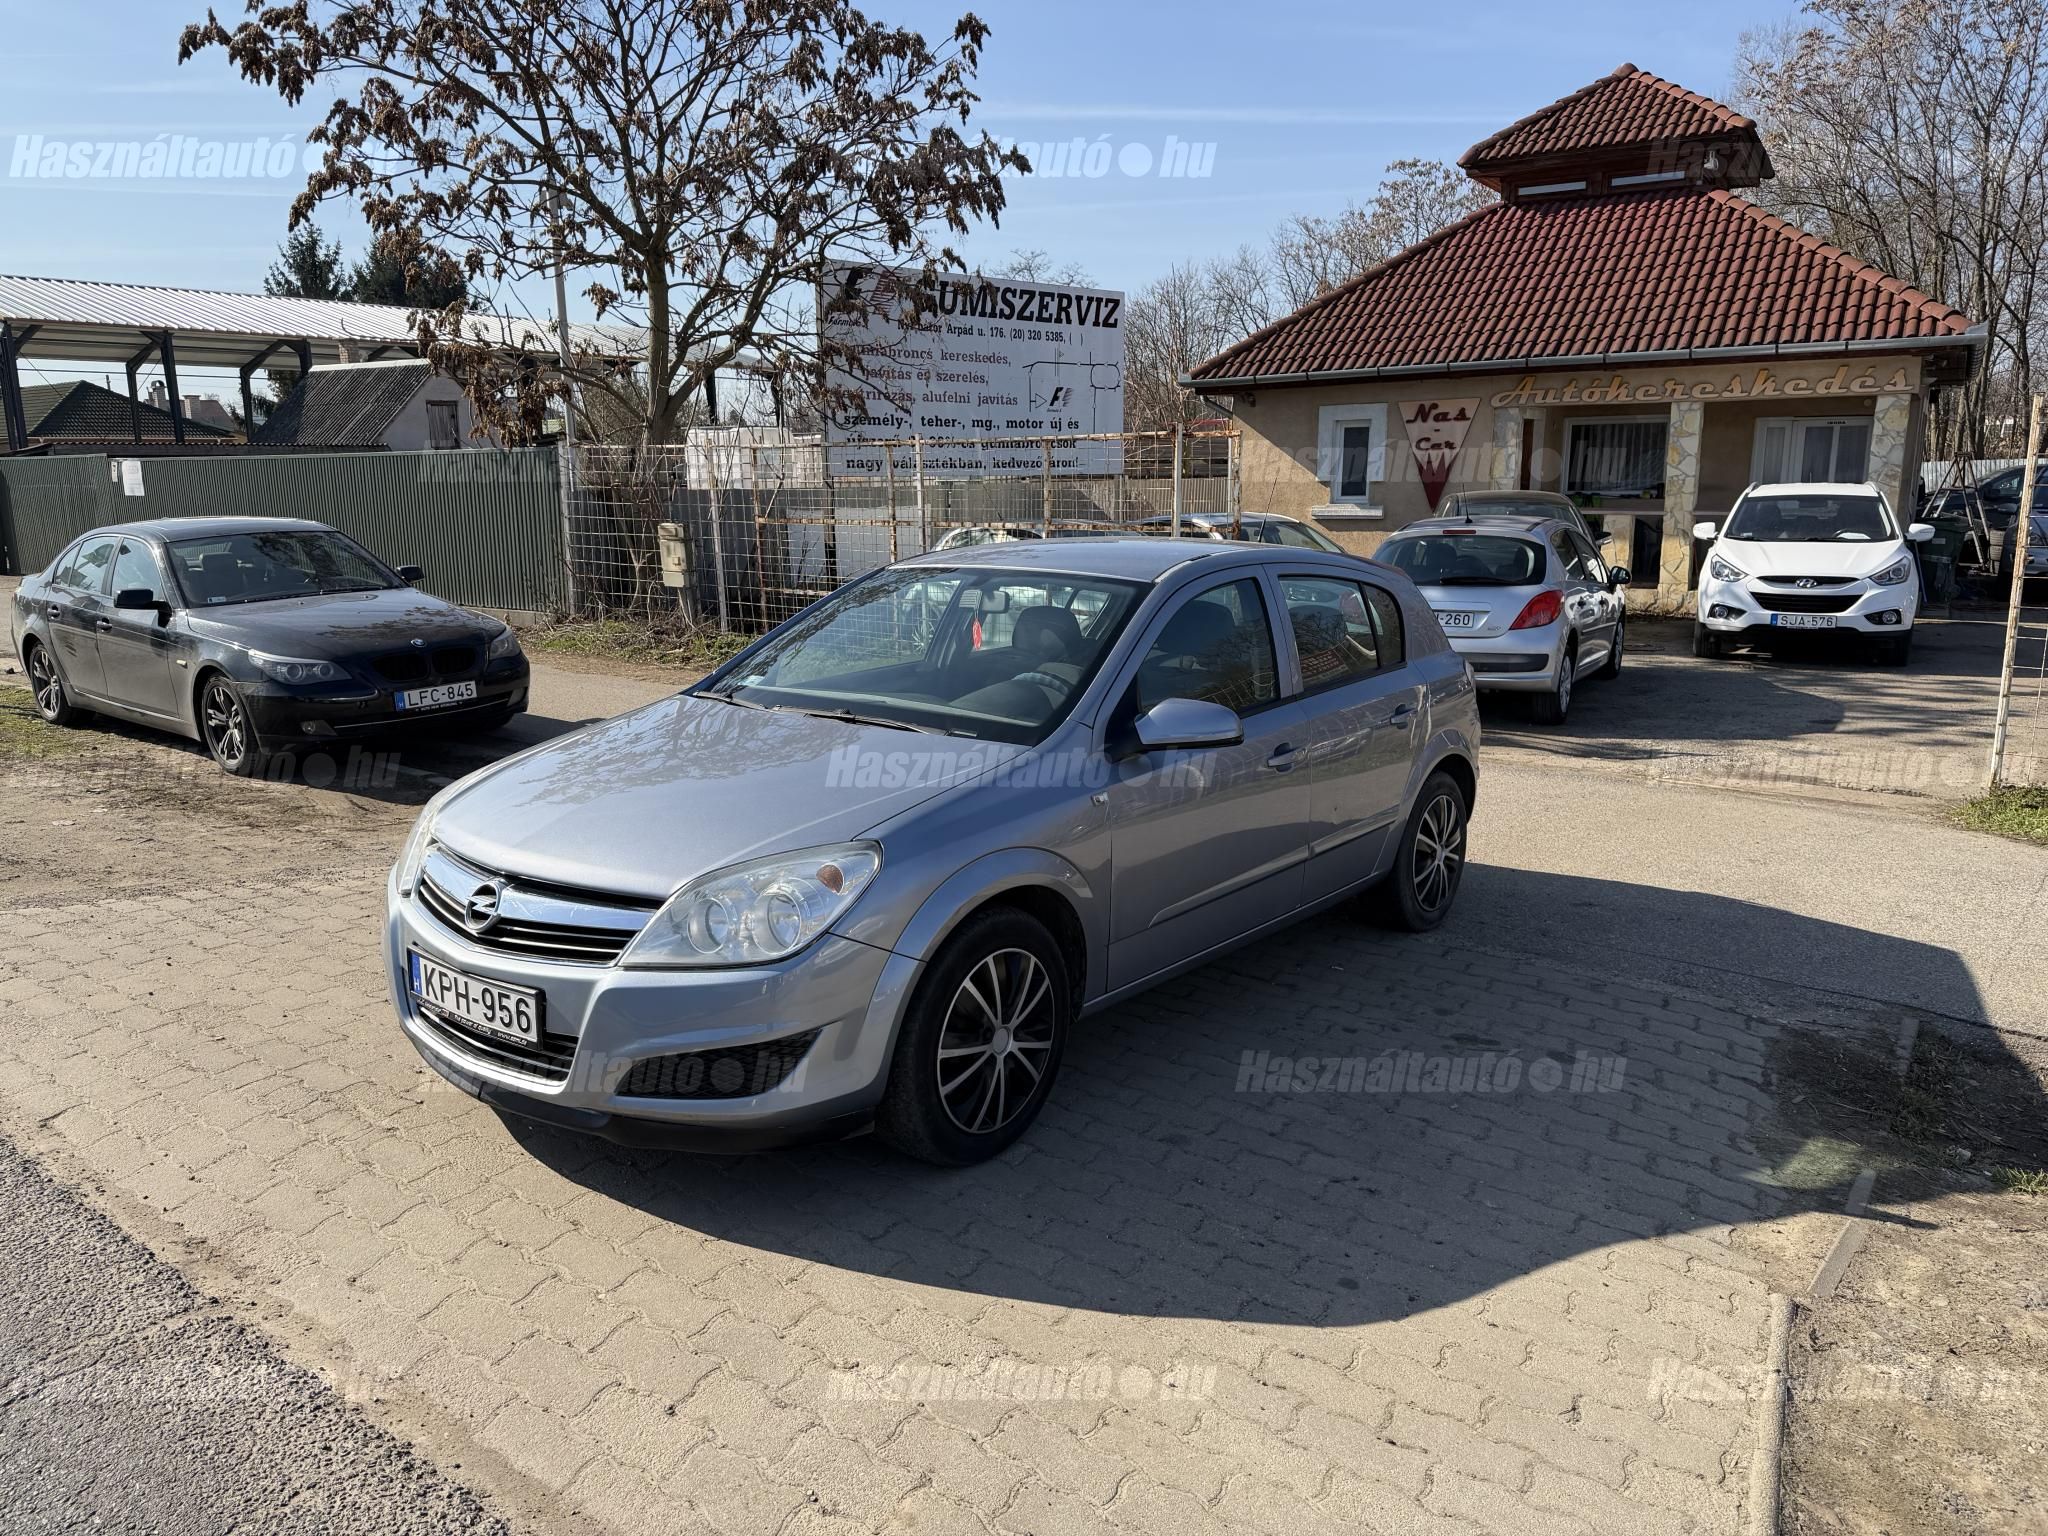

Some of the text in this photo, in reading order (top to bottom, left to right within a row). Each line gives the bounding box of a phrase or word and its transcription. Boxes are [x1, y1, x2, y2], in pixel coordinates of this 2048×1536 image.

[990, 327, 1006, 338] 176.
[1010, 328, 1025, 342] (20)
[1028, 329, 1041, 341] 320
[941, 349, 1011, 366] kereskedés,
[936, 370, 989, 386] szerelés,
[1490, 365, 1914, 408] Autókereskedés
[922, 390, 971, 404] alufelni
[977, 392, 1018, 407] javítás
[1405, 402, 1471, 423] Nas
[921, 415, 966, 430] teher-,
[1005, 419, 1043, 429] motor
[1050, 417, 1062, 431] új
[1067, 418, 1080, 430] és
[981, 437, 1077, 451] gumiabrocsok
[846, 457, 884, 472] nagy
[1780, 615, 1834, 627] SJA-576
[407, 683, 474, 706] LFC-845
[423, 963, 532, 1034] KPH-956
